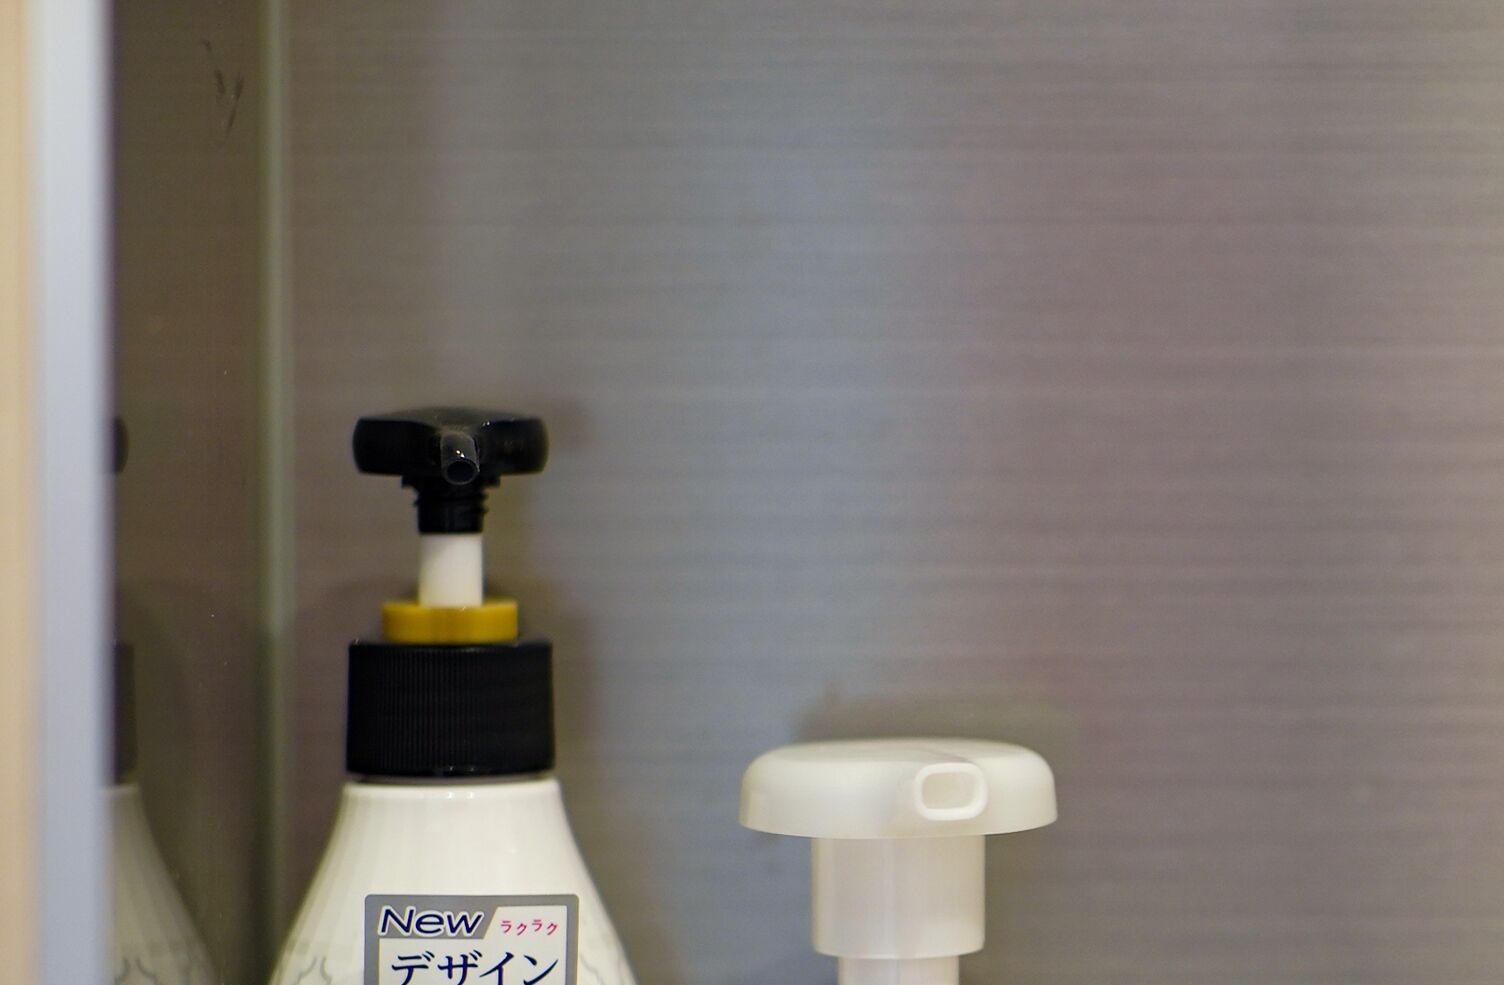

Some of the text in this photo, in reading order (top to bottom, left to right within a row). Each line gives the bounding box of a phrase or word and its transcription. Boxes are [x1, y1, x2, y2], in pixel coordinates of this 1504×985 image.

[379, 907, 484, 936] New
[500, 919, 558, 936] ラクラク
